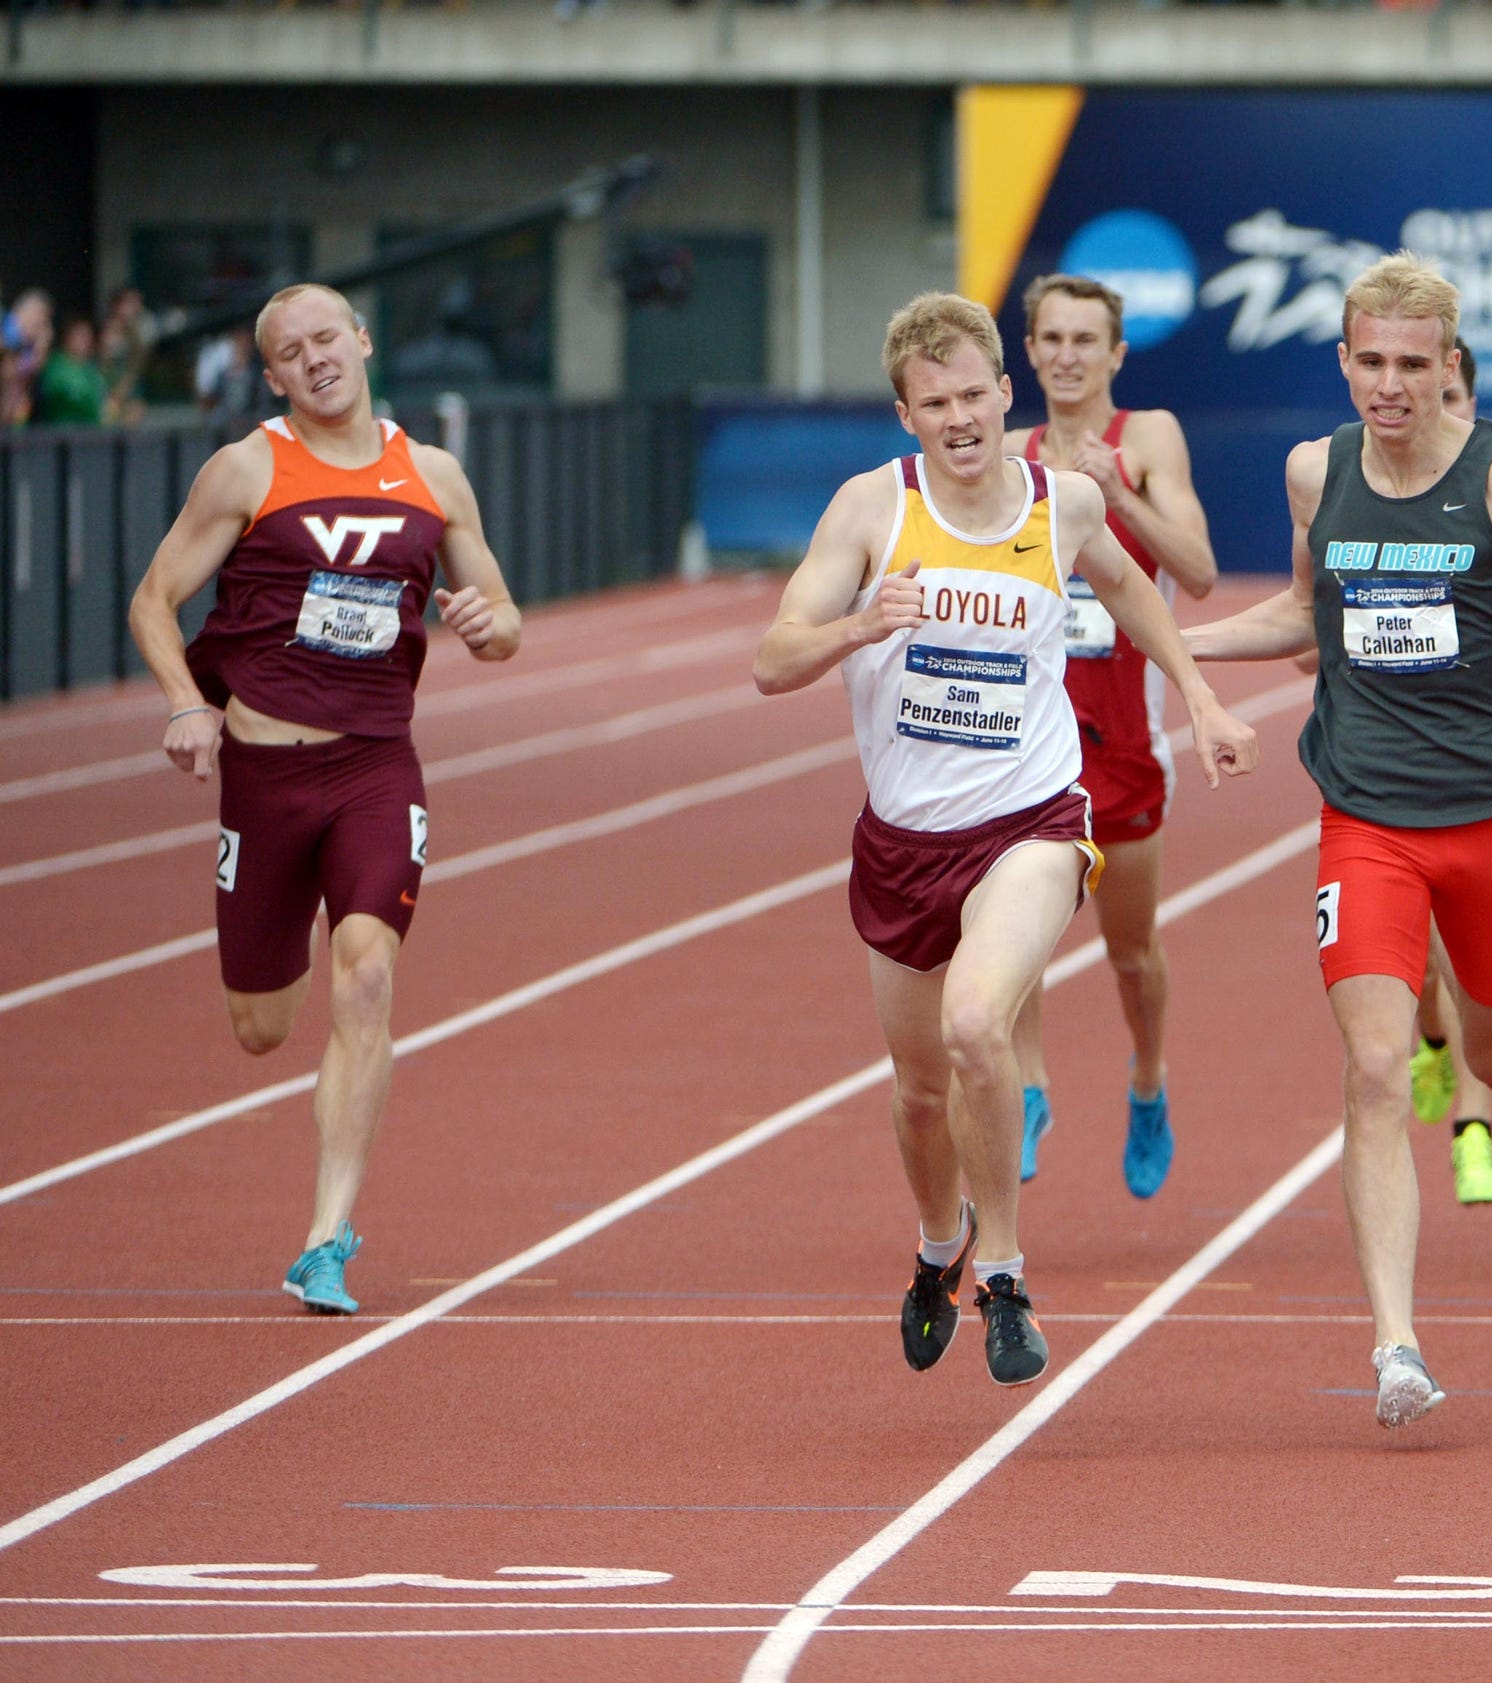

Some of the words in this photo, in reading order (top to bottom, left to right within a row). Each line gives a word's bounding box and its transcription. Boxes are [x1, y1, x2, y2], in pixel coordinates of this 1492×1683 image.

[301, 515, 408, 566] VT
[1325, 541, 1378, 570] NEW
[1378, 542, 1475, 572] MEXICO
[919, 586, 1027, 630] LOYOLA
[1371, 592, 1446, 602] CHAMPIONSHIPS
[1376, 616, 1412, 631] Peter
[1362, 635, 1436, 655] Callahan
[942, 663, 1022, 678] CHAMPIONSHIPS
[947, 686, 980, 704] Sam
[900, 698, 1022, 732] Penzenstadler
[217, 832, 231, 883] 2
